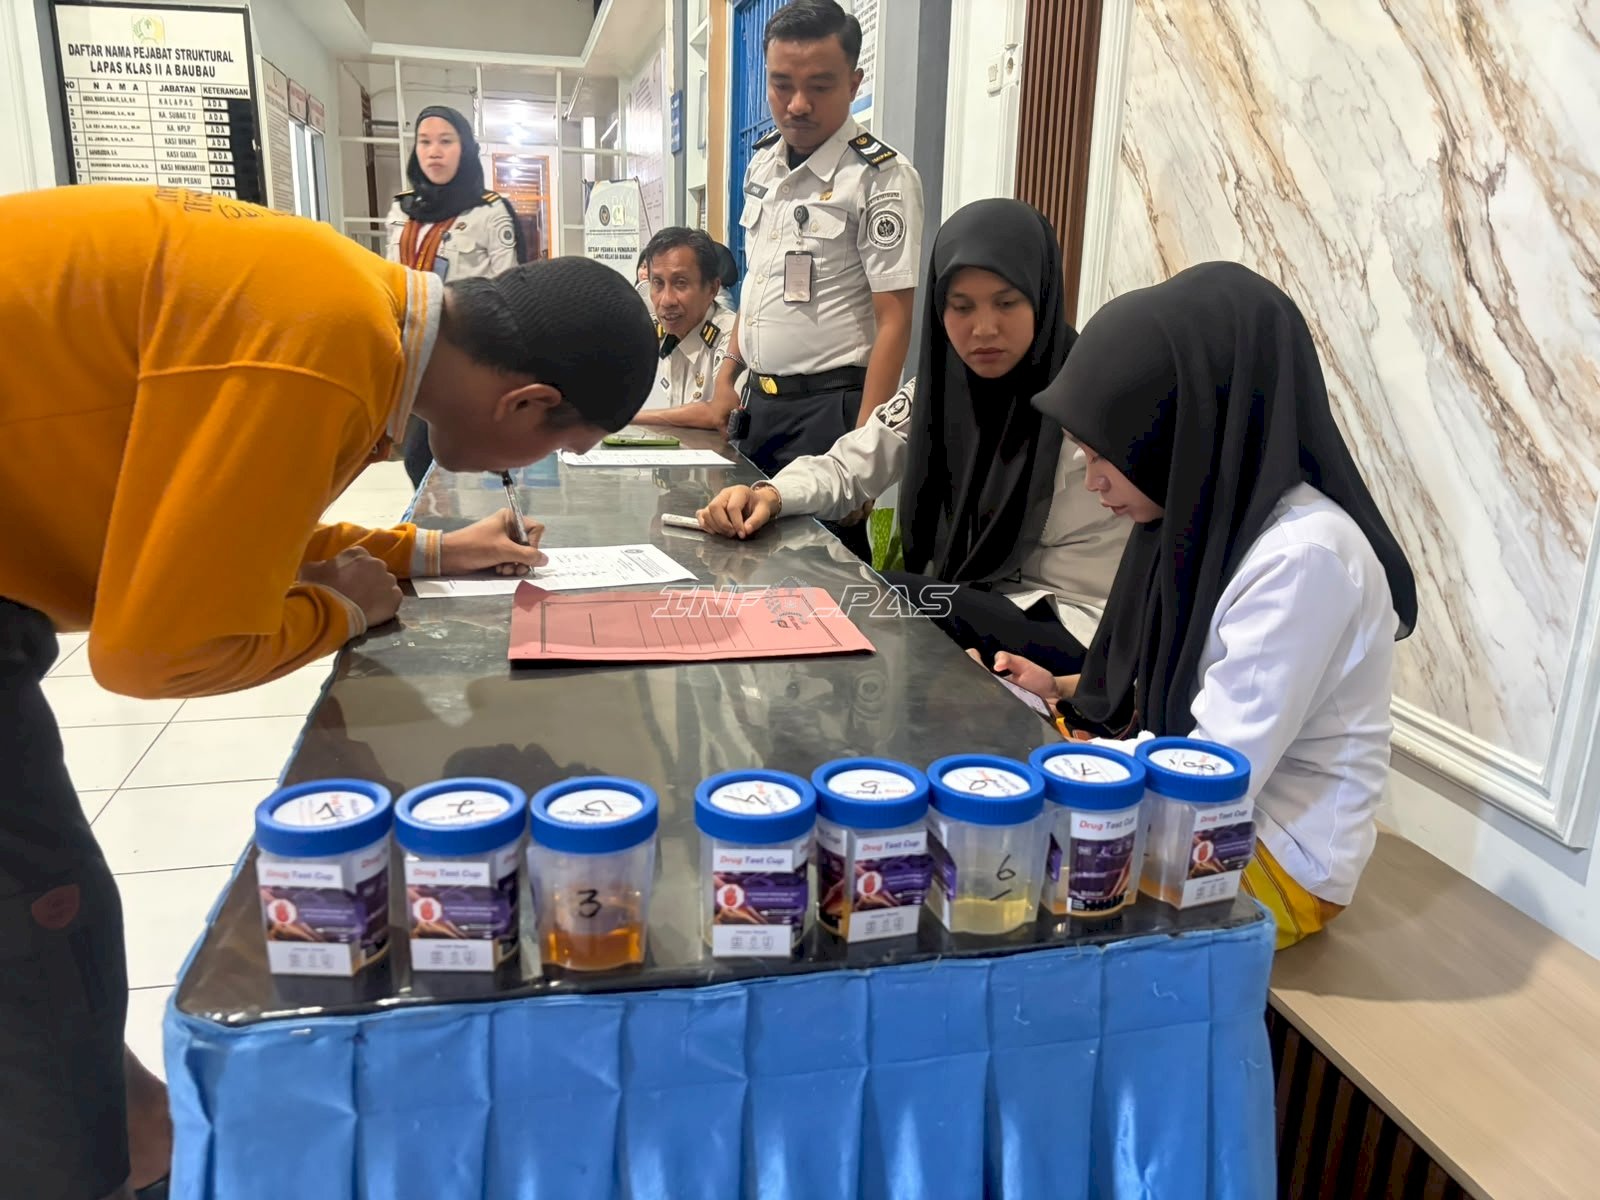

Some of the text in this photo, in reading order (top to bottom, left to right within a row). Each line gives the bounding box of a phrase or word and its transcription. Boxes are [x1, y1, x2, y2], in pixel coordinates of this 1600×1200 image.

[68, 44, 234, 63] DAFTAR NAMA PEJABAT STRUKTURAL
[90, 61, 216, 78] LAPAS KLAS II A BAUBAU
[160, 85, 195, 93] JABATAN
[203, 88, 248, 96] KETERANGAN
[208, 100, 222, 108] ADA
[213, 152, 228, 160] ADA
[1079, 820, 1103, 831] Drug
[1105, 821, 1122, 829] Test
[863, 840, 920, 852] Drug Test Cup
[720, 855, 785, 865] Drug Test Cup
[997, 854, 1016, 881] 6
[266, 870, 334, 881] Drug Test Cup
[413, 868, 482, 879] Drug Test Cup
[578, 889, 602, 918] 3
